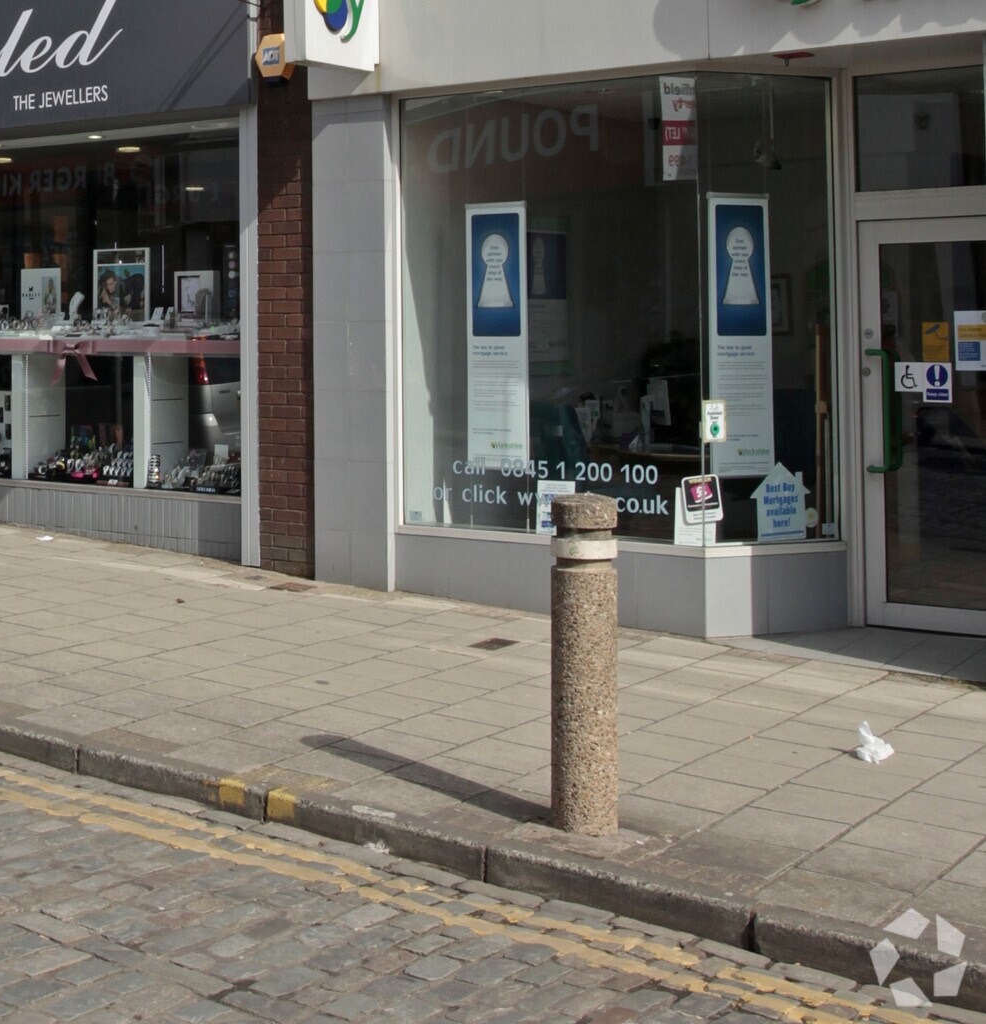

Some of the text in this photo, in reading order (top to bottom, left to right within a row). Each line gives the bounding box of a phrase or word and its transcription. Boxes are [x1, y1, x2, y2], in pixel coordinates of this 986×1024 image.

[262, 49, 280, 64] ADT
[13, 84, 109, 112] THE JEWELLERS
[452, 457, 658, 485] call 0845 1 200 100
[765, 482, 795, 494] Best Buy
[462, 485, 508, 505] click
[763, 494, 799, 506] Mortgages
[766, 505, 797, 517] available
[772, 518, 791, 529] here!
